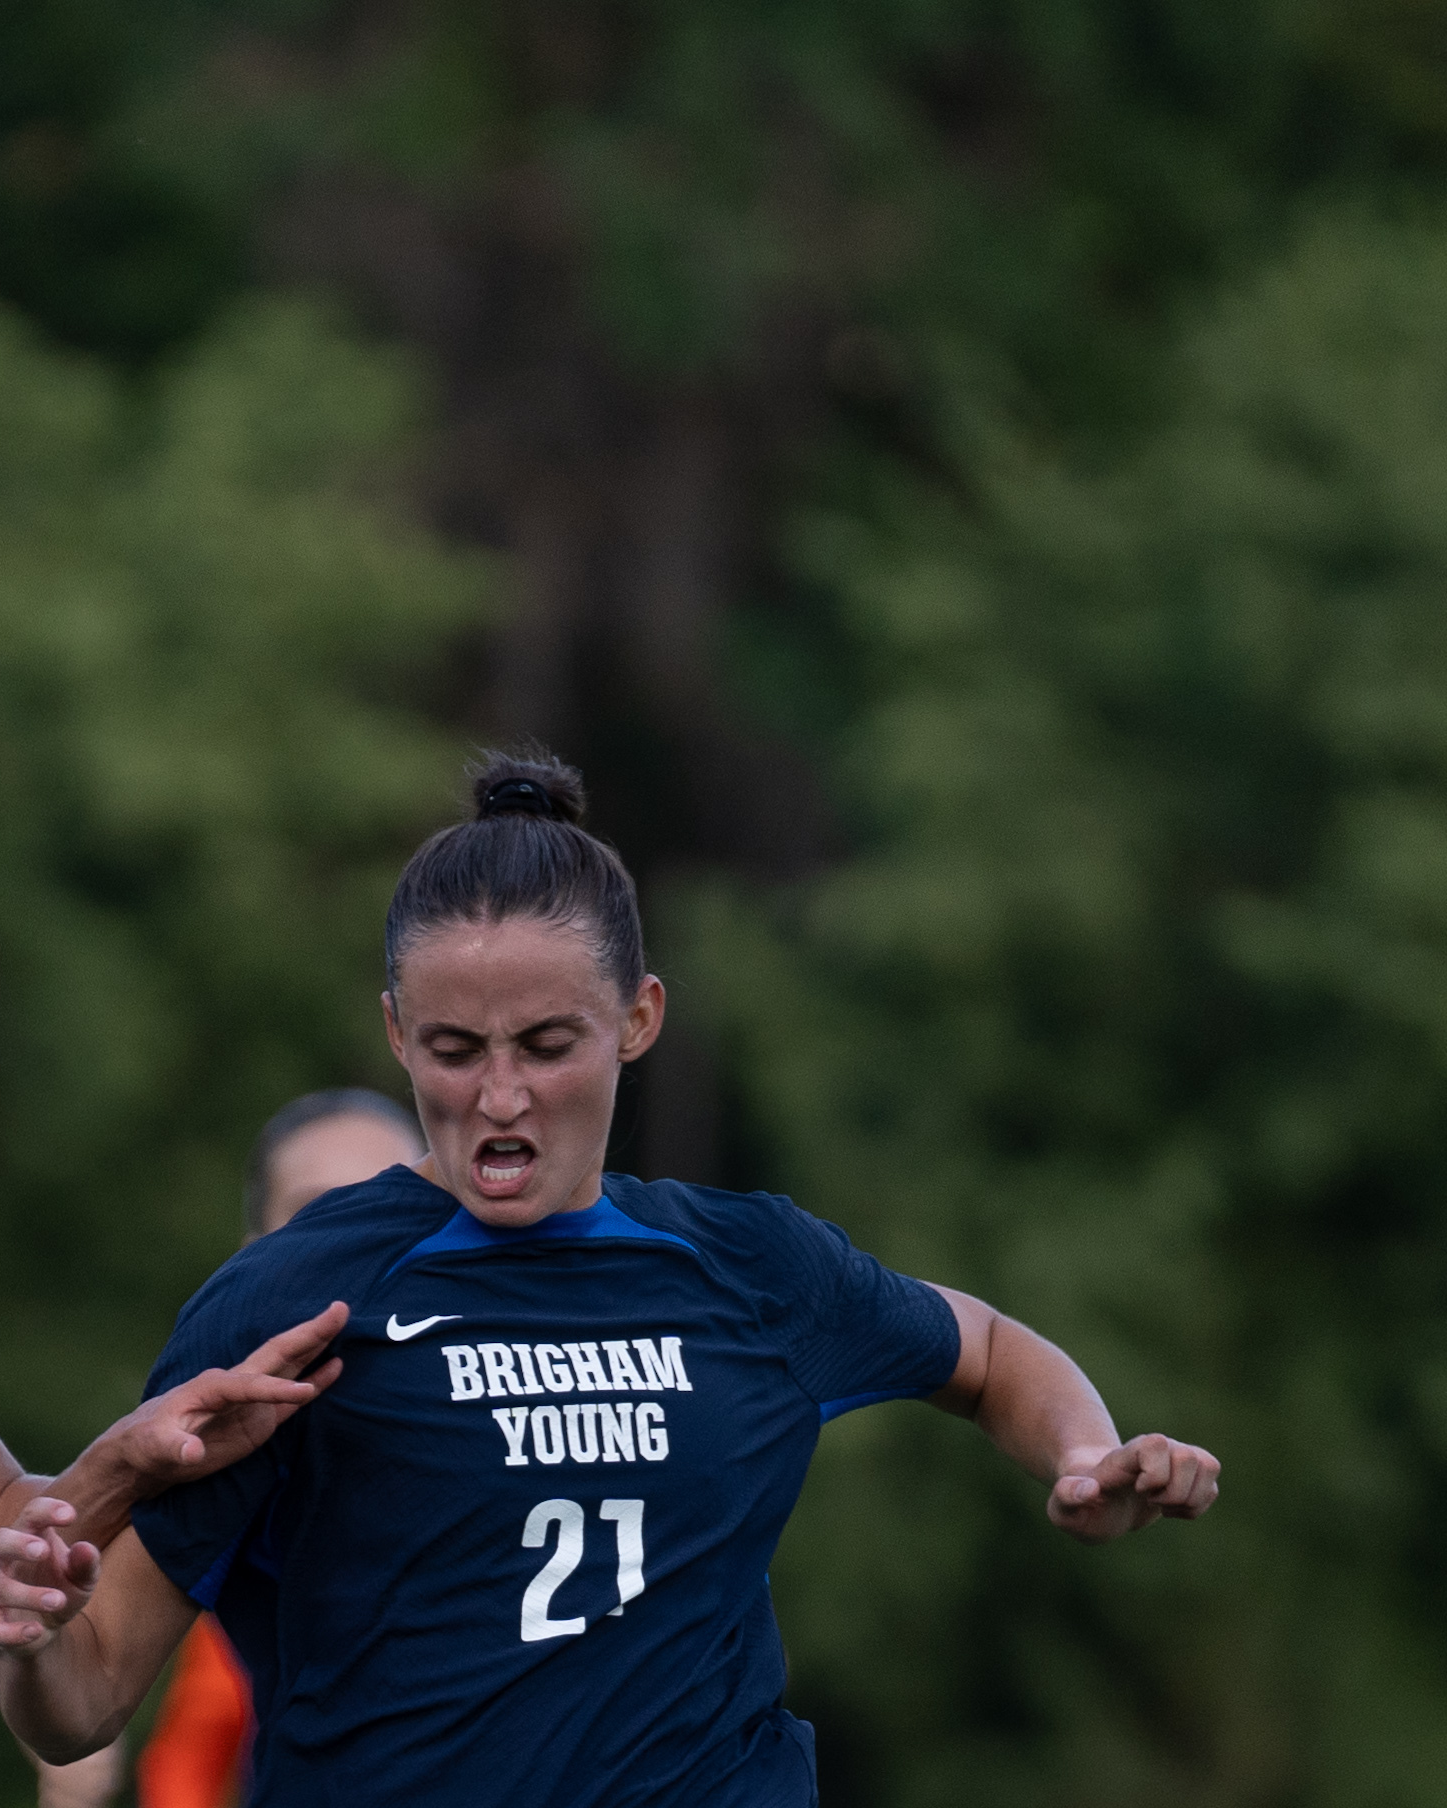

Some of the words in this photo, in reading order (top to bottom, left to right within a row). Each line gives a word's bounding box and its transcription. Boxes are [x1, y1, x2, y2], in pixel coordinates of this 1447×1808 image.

[441, 1336, 693, 1401] BRIGHAM
[491, 1402, 670, 1466] YOUNG
[520, 1498, 646, 1643] 21
